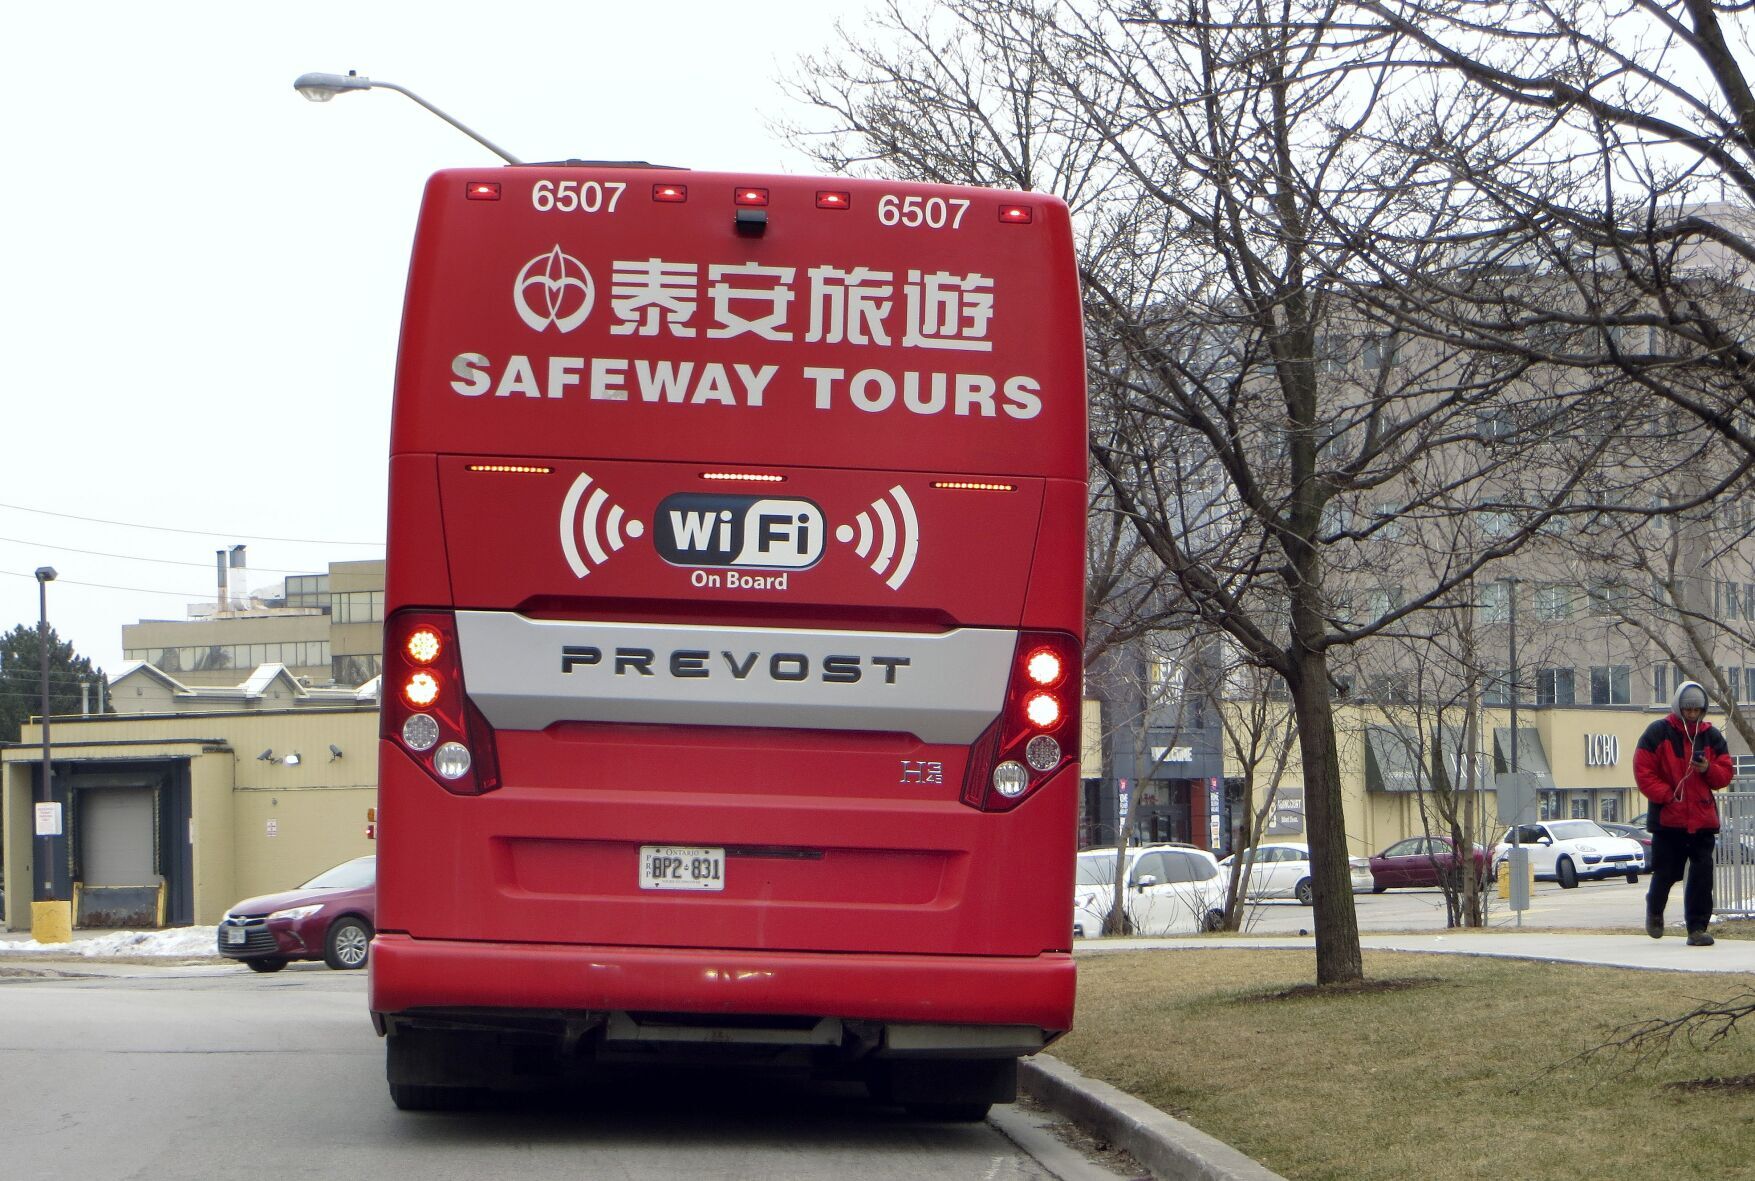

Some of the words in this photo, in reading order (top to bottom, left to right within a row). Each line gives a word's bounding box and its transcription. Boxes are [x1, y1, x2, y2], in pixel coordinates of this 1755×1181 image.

[531, 179, 627, 213] 6507
[877, 194, 970, 230] 6507
[609, 257, 995, 352] 泰安旅遊
[450, 352, 779, 407] SAFEWAY
[803, 366, 1043, 420] TOURS
[691, 570, 721, 588] On
[726, 571, 788, 590] Board
[561, 645, 911, 685] PREVOST
[1587, 734, 1619, 765] LCBO
